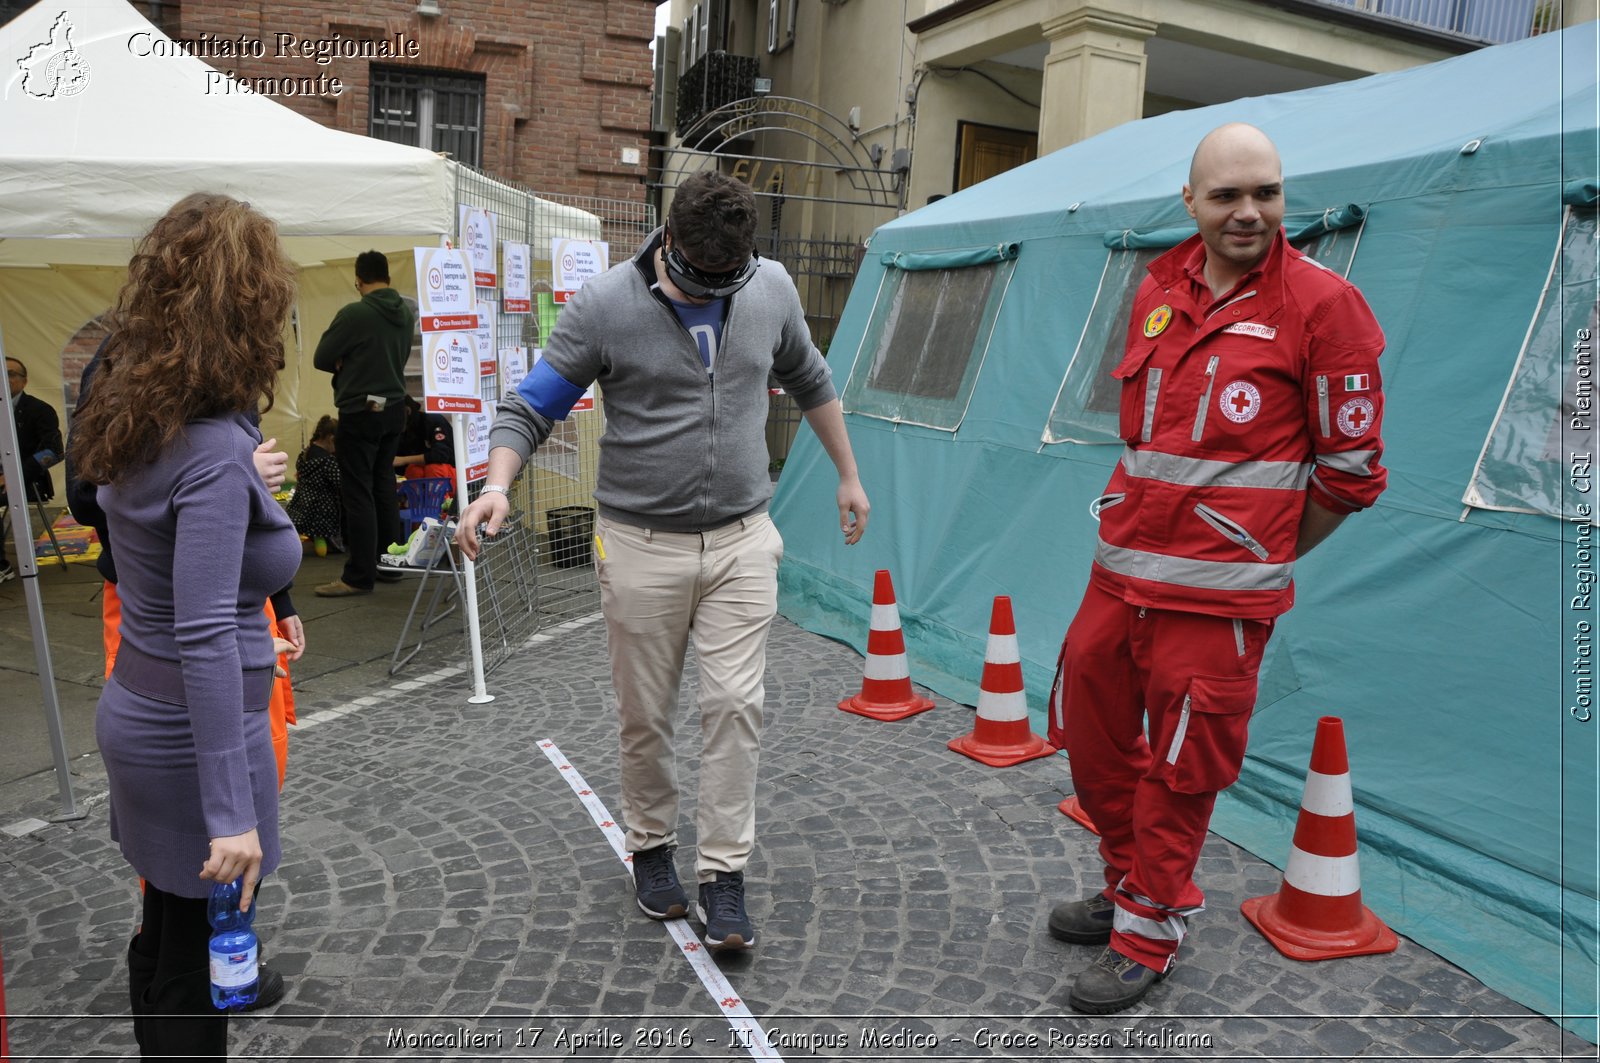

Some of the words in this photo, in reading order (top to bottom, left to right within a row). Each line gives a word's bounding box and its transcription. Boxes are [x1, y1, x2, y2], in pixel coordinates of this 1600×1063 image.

[564, 259, 572, 267] 10
[431, 274, 440, 284] 10
[444, 273, 459, 281] sempre
[1228, 324, 1275, 337] OCCORRITORE
[438, 355, 446, 365] 10
